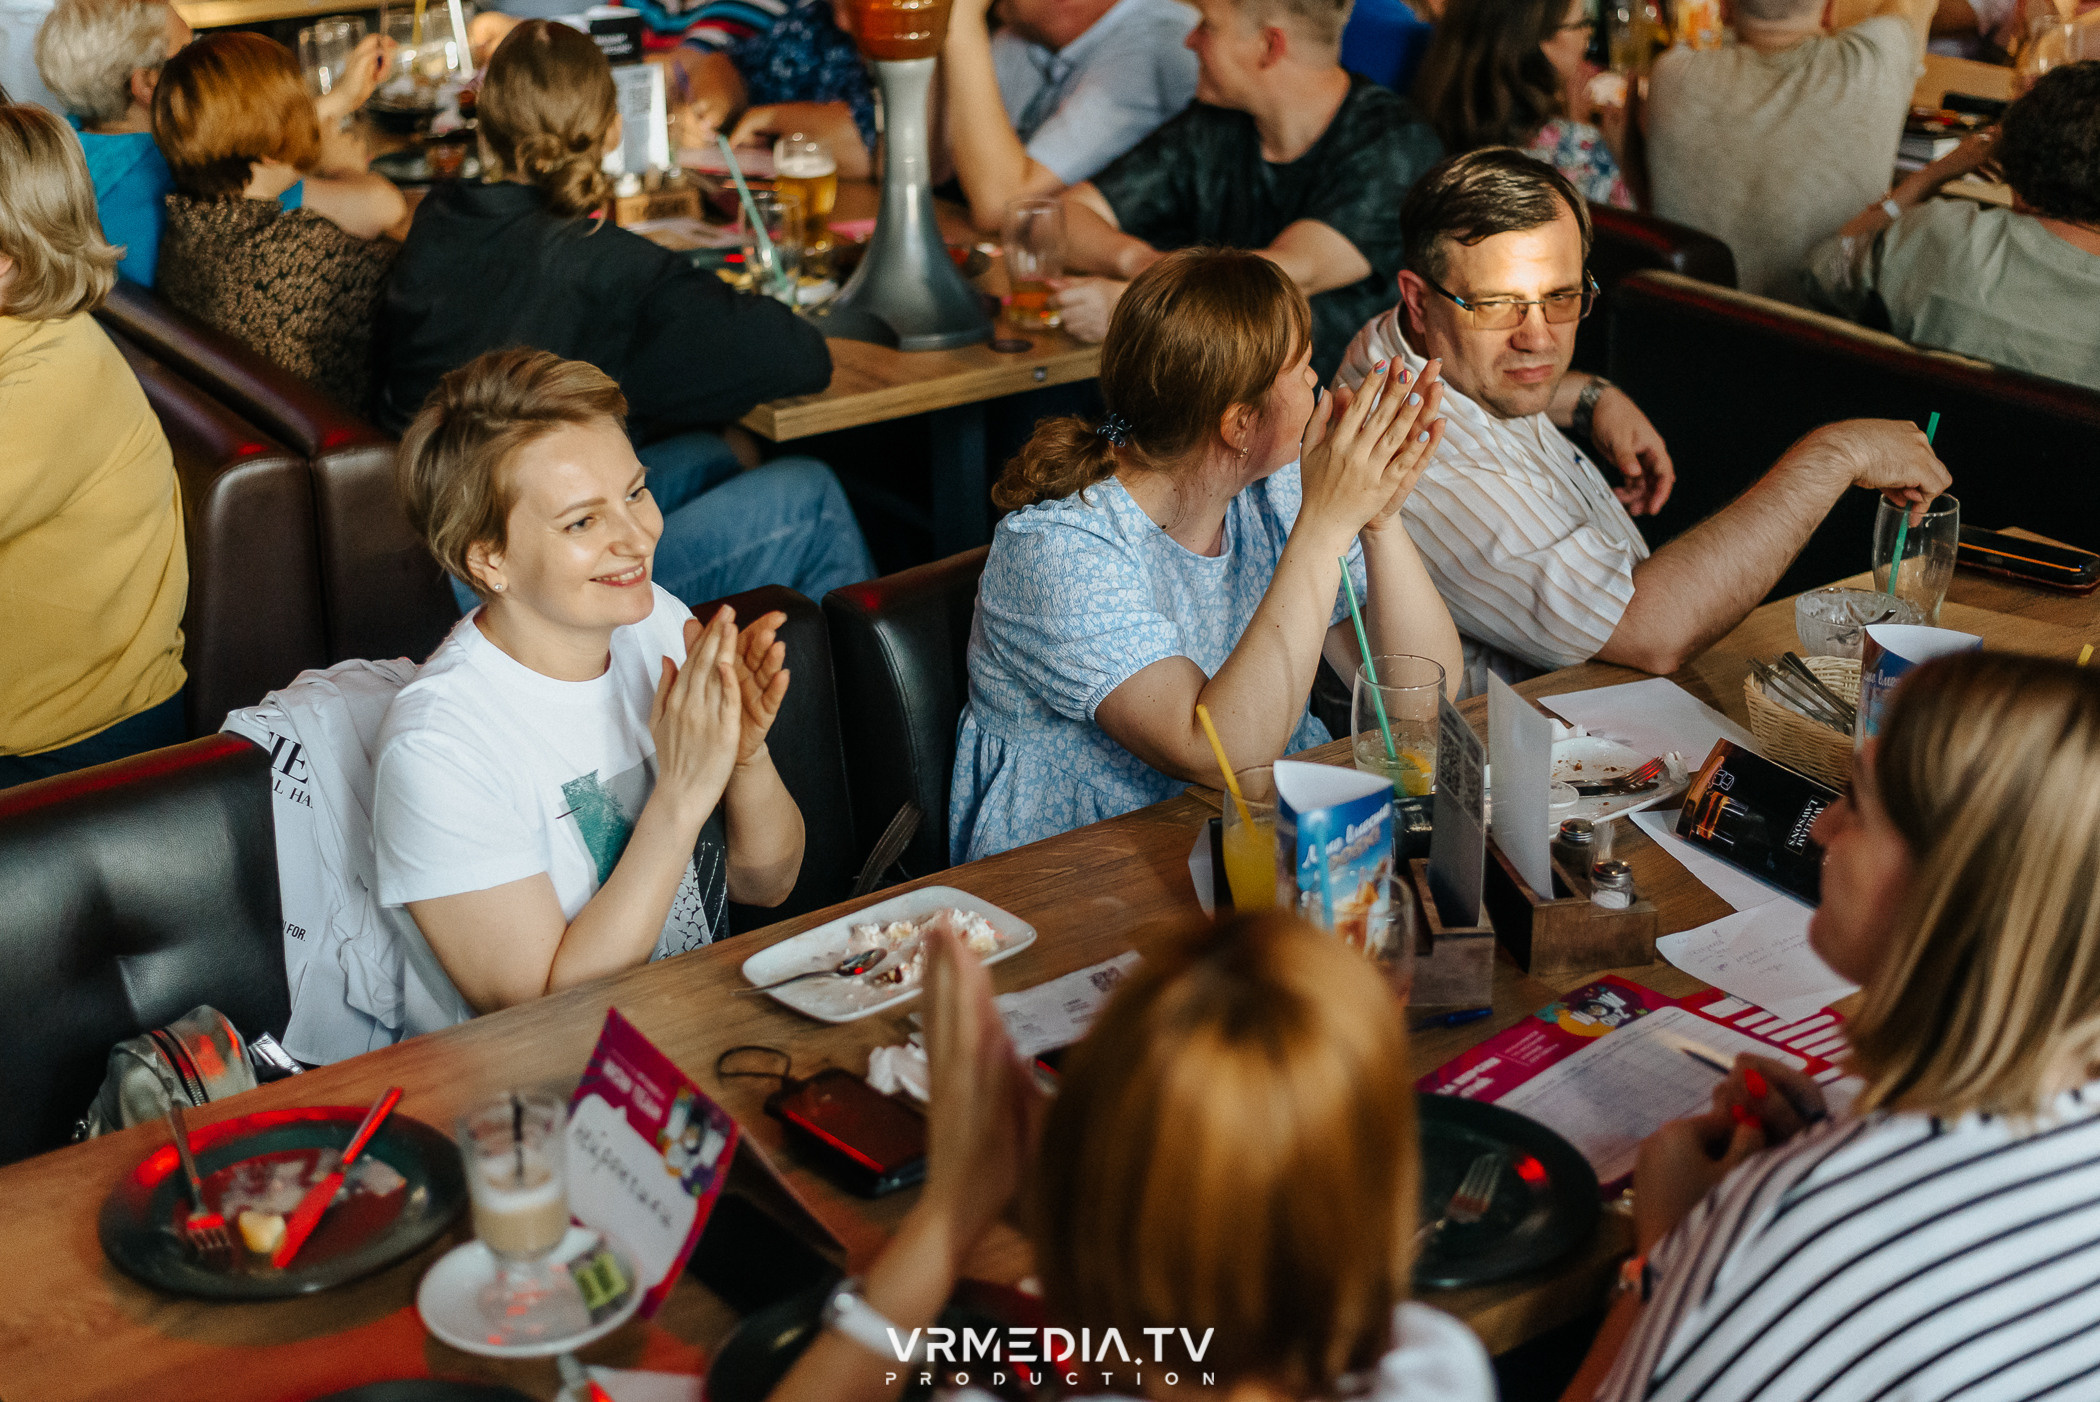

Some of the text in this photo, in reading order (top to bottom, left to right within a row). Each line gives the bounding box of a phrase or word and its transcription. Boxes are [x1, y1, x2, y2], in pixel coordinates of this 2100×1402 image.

[269, 731, 309, 784] IE
[1788, 799, 1818, 847] LAWSON'S
[1796, 807, 1824, 847] WILLIAM
[286, 923, 307, 942] FOR.
